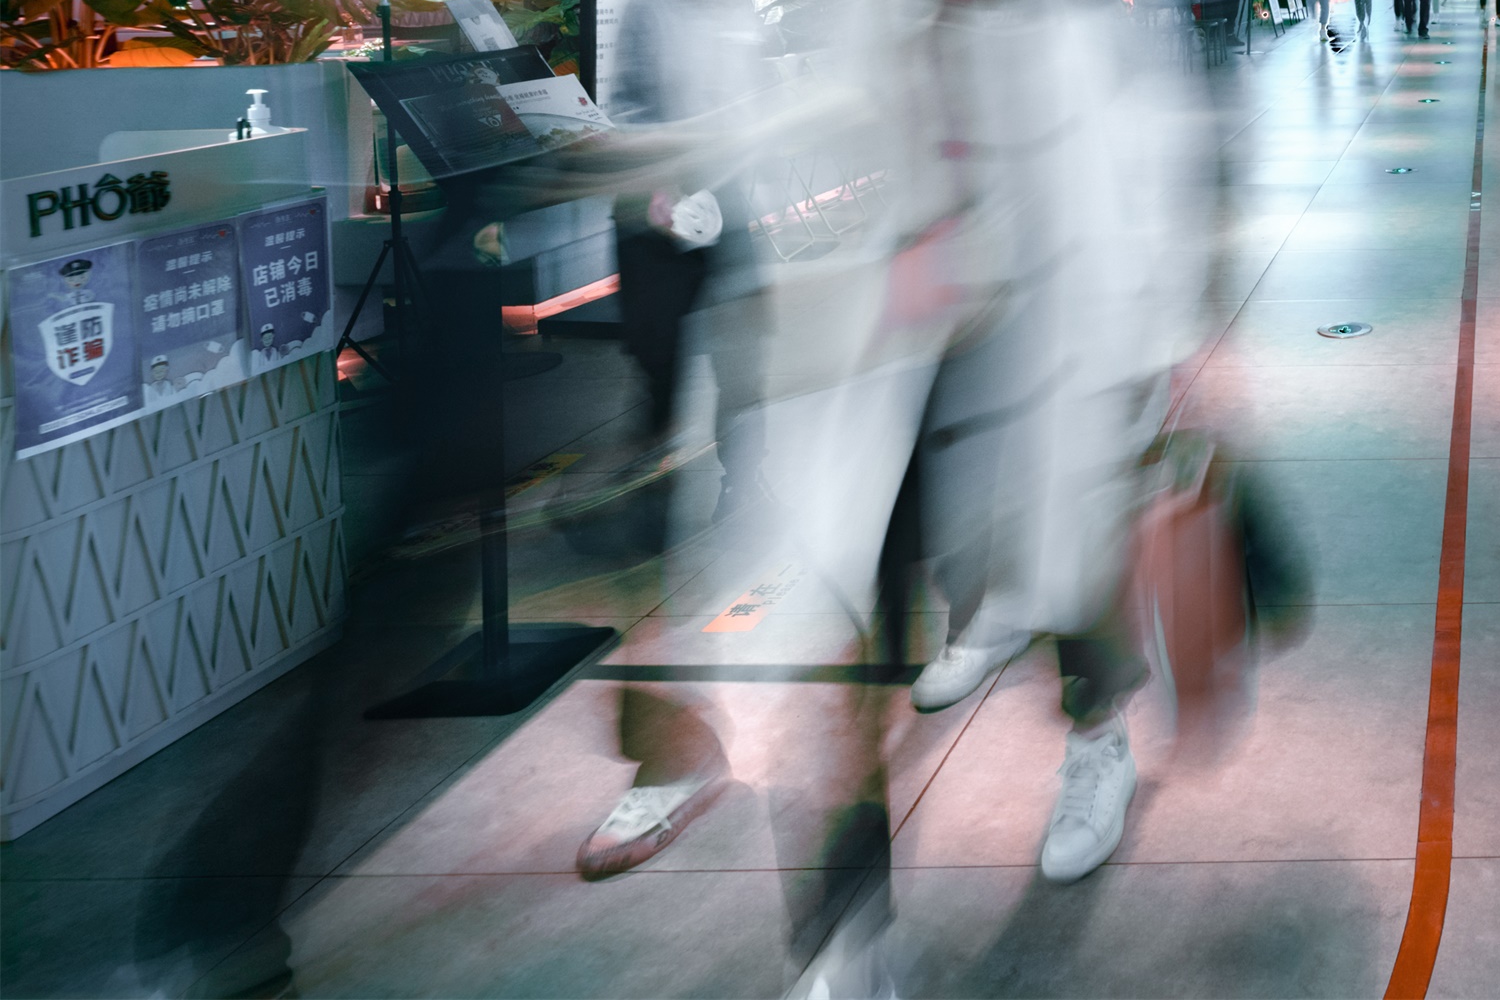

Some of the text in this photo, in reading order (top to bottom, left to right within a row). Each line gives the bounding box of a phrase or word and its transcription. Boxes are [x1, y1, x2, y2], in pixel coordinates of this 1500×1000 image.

[264, 228, 306, 247] 温馨提示
[252, 251, 319, 286] 店铺今日
[143, 275, 233, 312] 疫情尚未解除
[264, 277, 313, 308] 已消毒
[54, 315, 104, 347] 谨防
[151, 299, 226, 334] 请勿摘口罩
[57, 337, 105, 370] 诈骗
